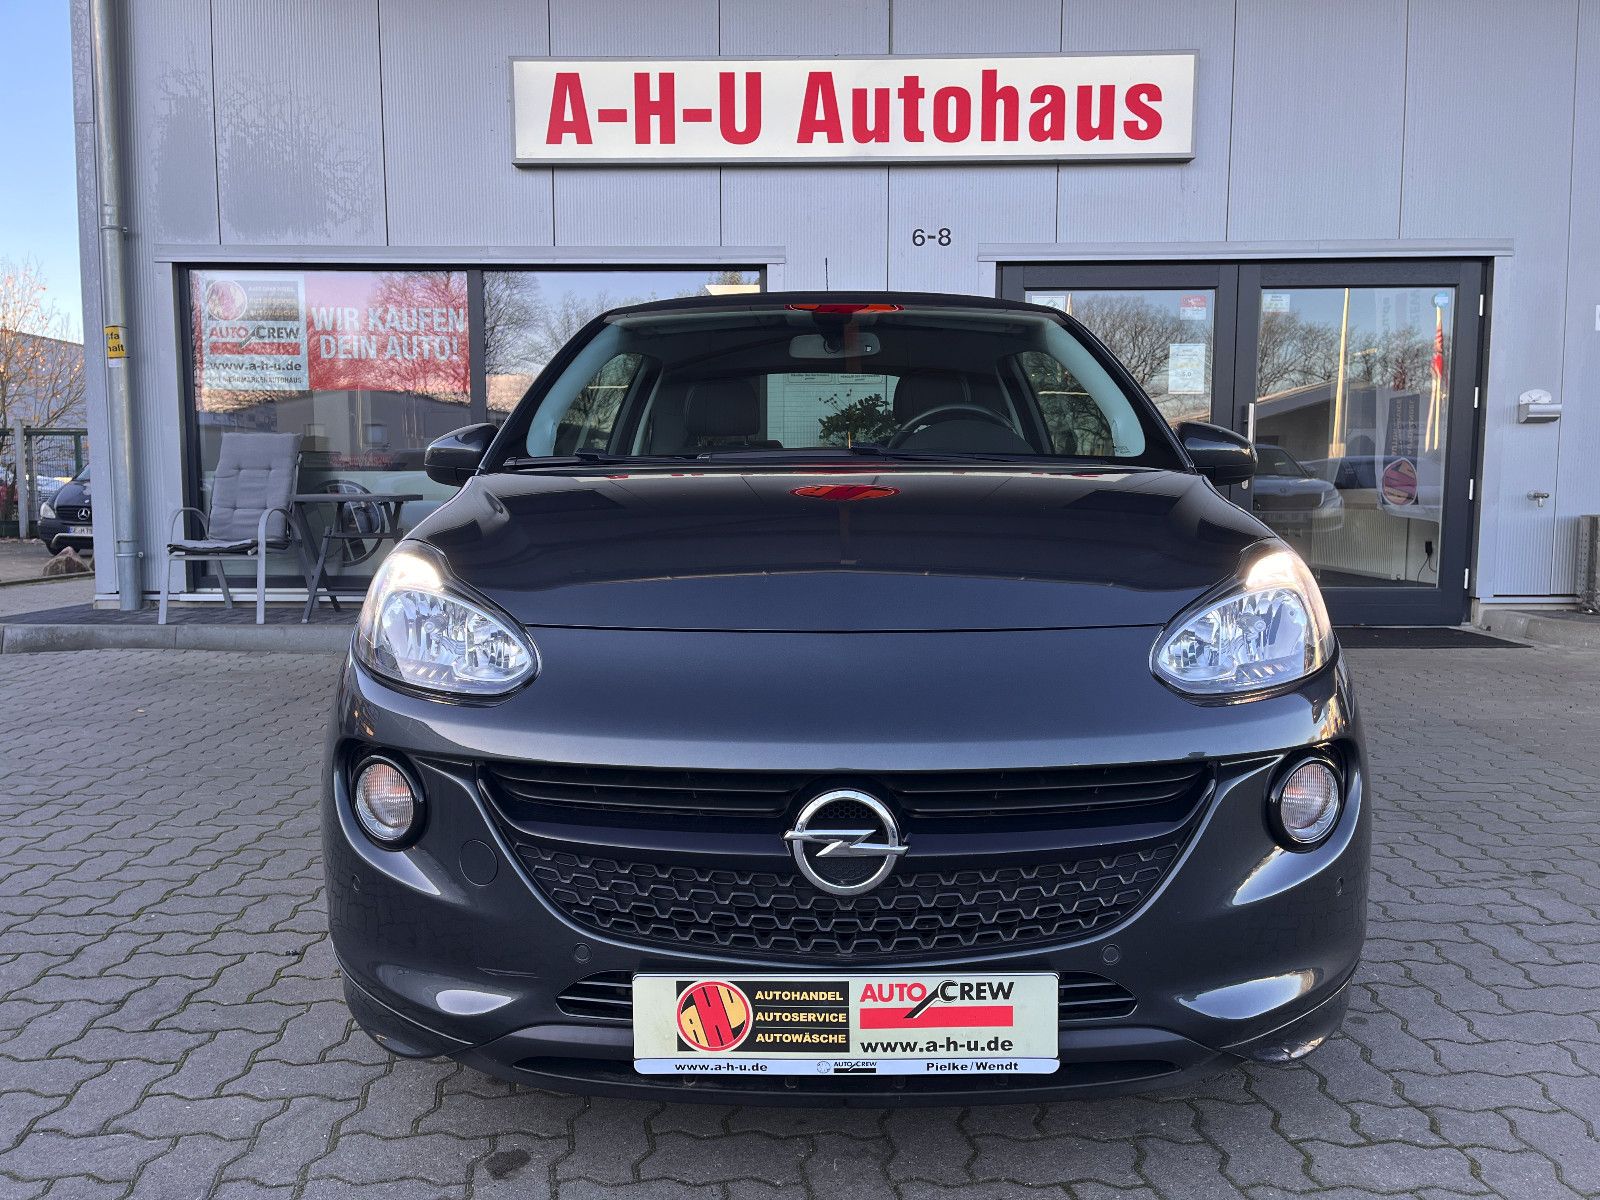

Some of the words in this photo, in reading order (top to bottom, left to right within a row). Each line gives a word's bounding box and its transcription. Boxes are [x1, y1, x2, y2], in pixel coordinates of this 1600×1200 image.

[546, 71, 762, 145] A-H-U
[796, 69, 1163, 144] Autohaus
[911, 228, 952, 247] 6-8
[311, 306, 360, 332] WIR
[367, 305, 465, 333] KAUFEN
[209, 327, 249, 339] AUTO
[255, 325, 300, 339] CREW
[319, 336, 377, 360] DEIN
[384, 335, 460, 361] AUTO!
[209, 361, 302, 371] www.a-h-u.de
[755, 991, 844, 1001] AUTOHANDEL
[859, 982, 927, 1003] AUTO
[938, 980, 1015, 1002] CREW
[755, 1012, 847, 1023] AUTOSERVICE
[755, 1032, 846, 1044] AUTOWÄSCHE
[859, 1037, 1014, 1053] www.a-h-u.de
[674, 1062, 769, 1073] www.a-h-u.de
[926, 1061, 1019, 1072] Pielke/Wendt
